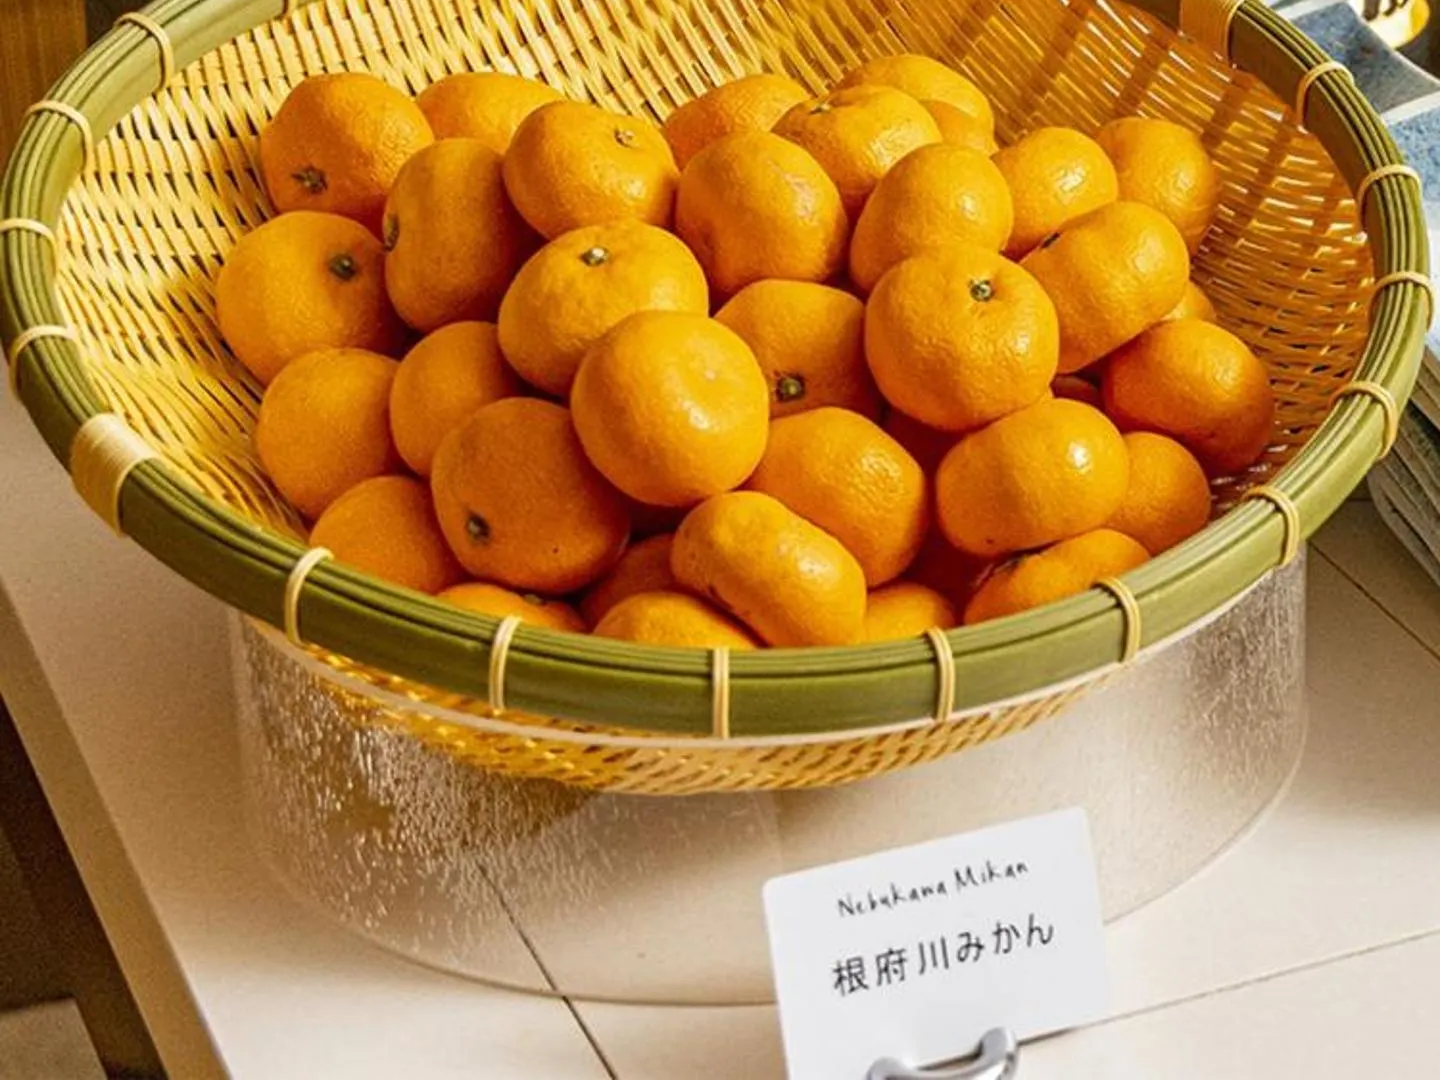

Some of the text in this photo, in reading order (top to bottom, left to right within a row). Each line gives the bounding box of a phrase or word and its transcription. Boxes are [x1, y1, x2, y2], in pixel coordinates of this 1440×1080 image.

[954, 859, 1029, 891] Mikan
[832, 912, 1054, 997] 根府川みかん
